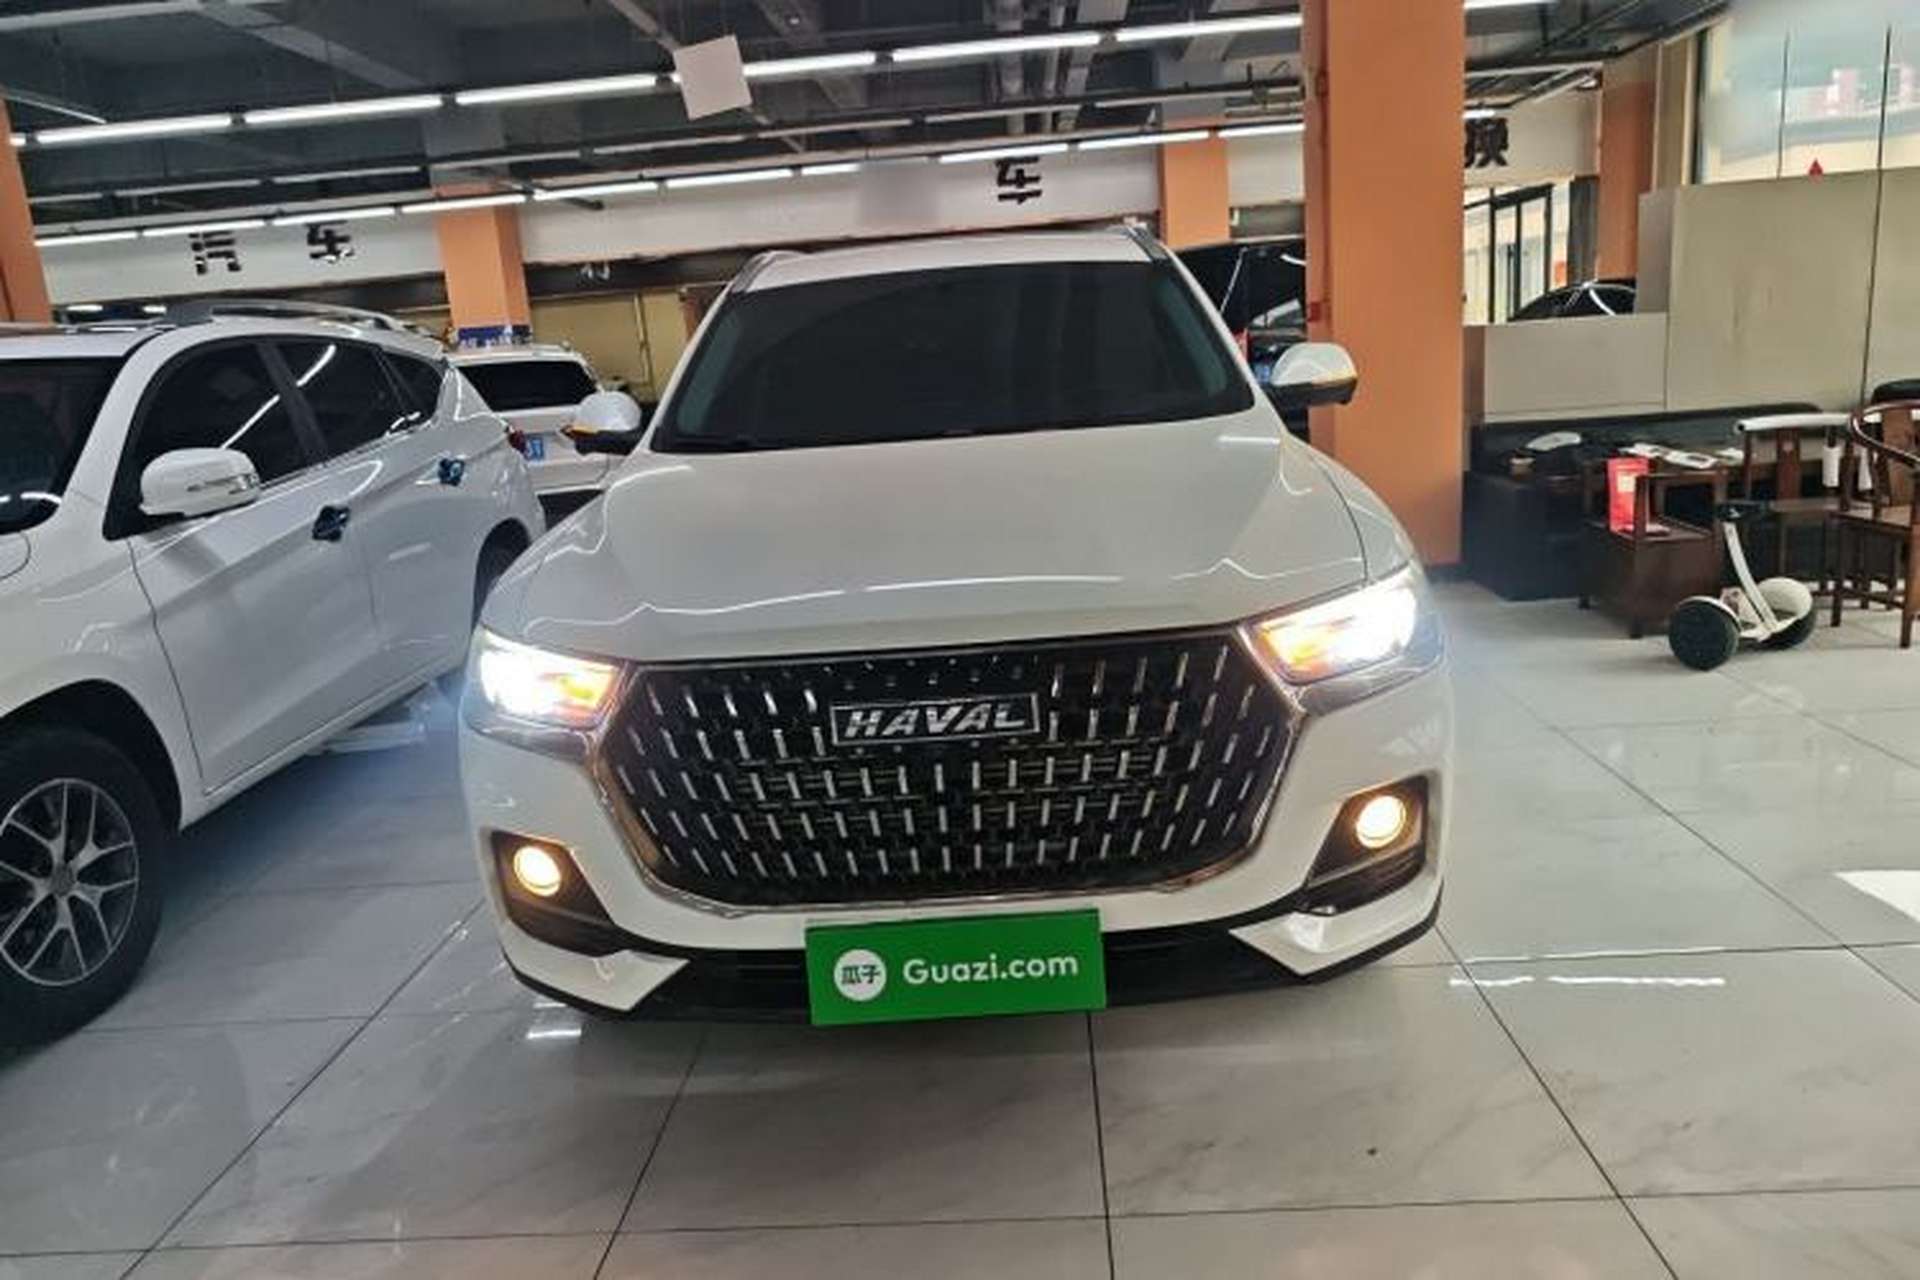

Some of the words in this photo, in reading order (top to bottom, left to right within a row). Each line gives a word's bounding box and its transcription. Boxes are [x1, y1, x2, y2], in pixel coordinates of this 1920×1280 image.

[844, 703, 1025, 737] HAVAL
[841, 964, 881, 985] 瓜子
[903, 953, 1078, 984] Guazi.com
